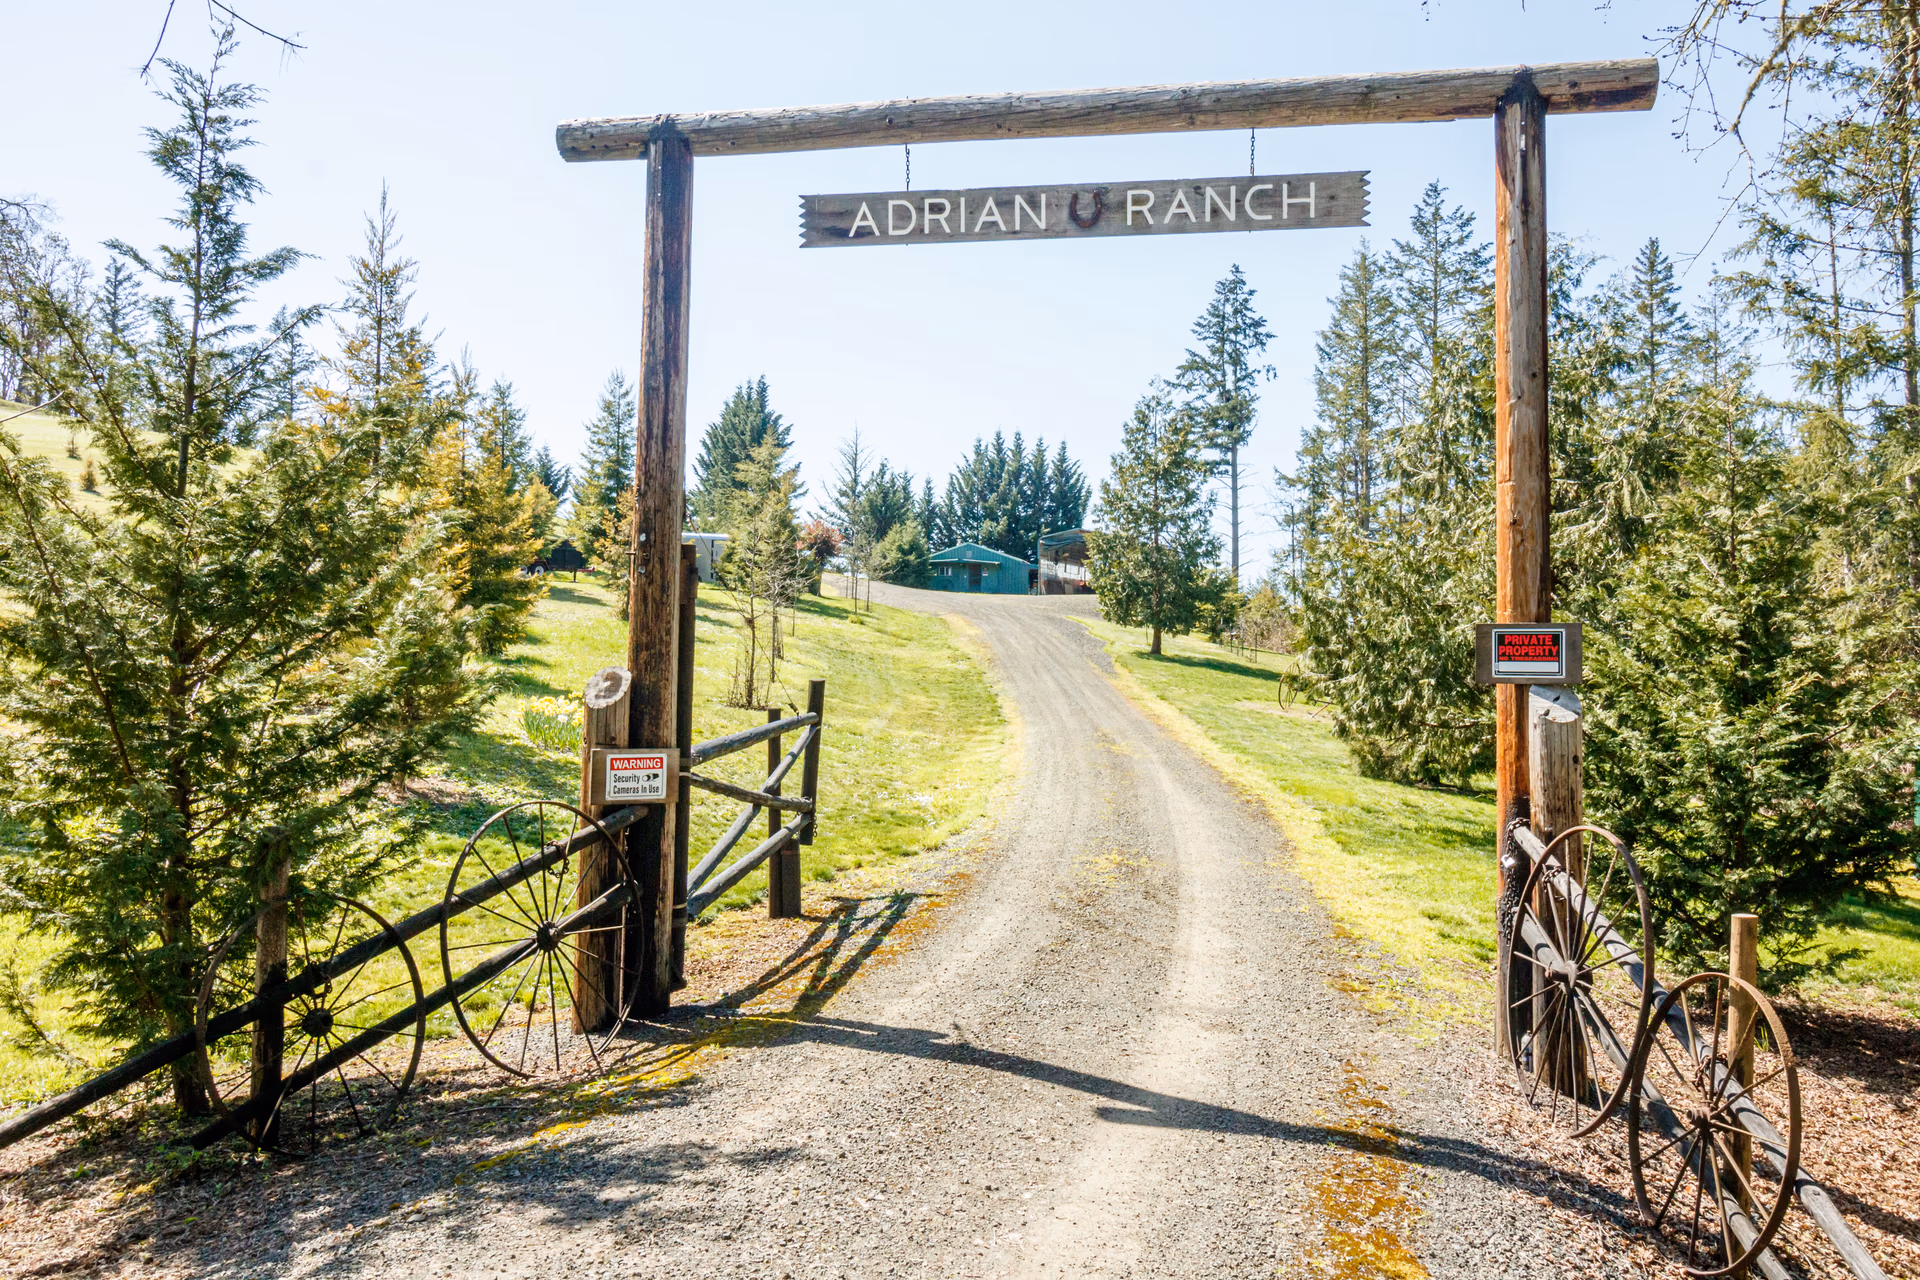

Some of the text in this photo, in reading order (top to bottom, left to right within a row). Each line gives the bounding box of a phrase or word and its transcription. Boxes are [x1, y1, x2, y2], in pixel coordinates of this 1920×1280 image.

[848, 182, 1316, 238] ADRIAN RANCH
[1504, 634, 1553, 645] PRIVATE
[1498, 645, 1559, 656] PROPERTY
[613, 759, 661, 769] WARNING
[613, 773, 640, 784] Security
[613, 785, 659, 795] Cameras In Use
